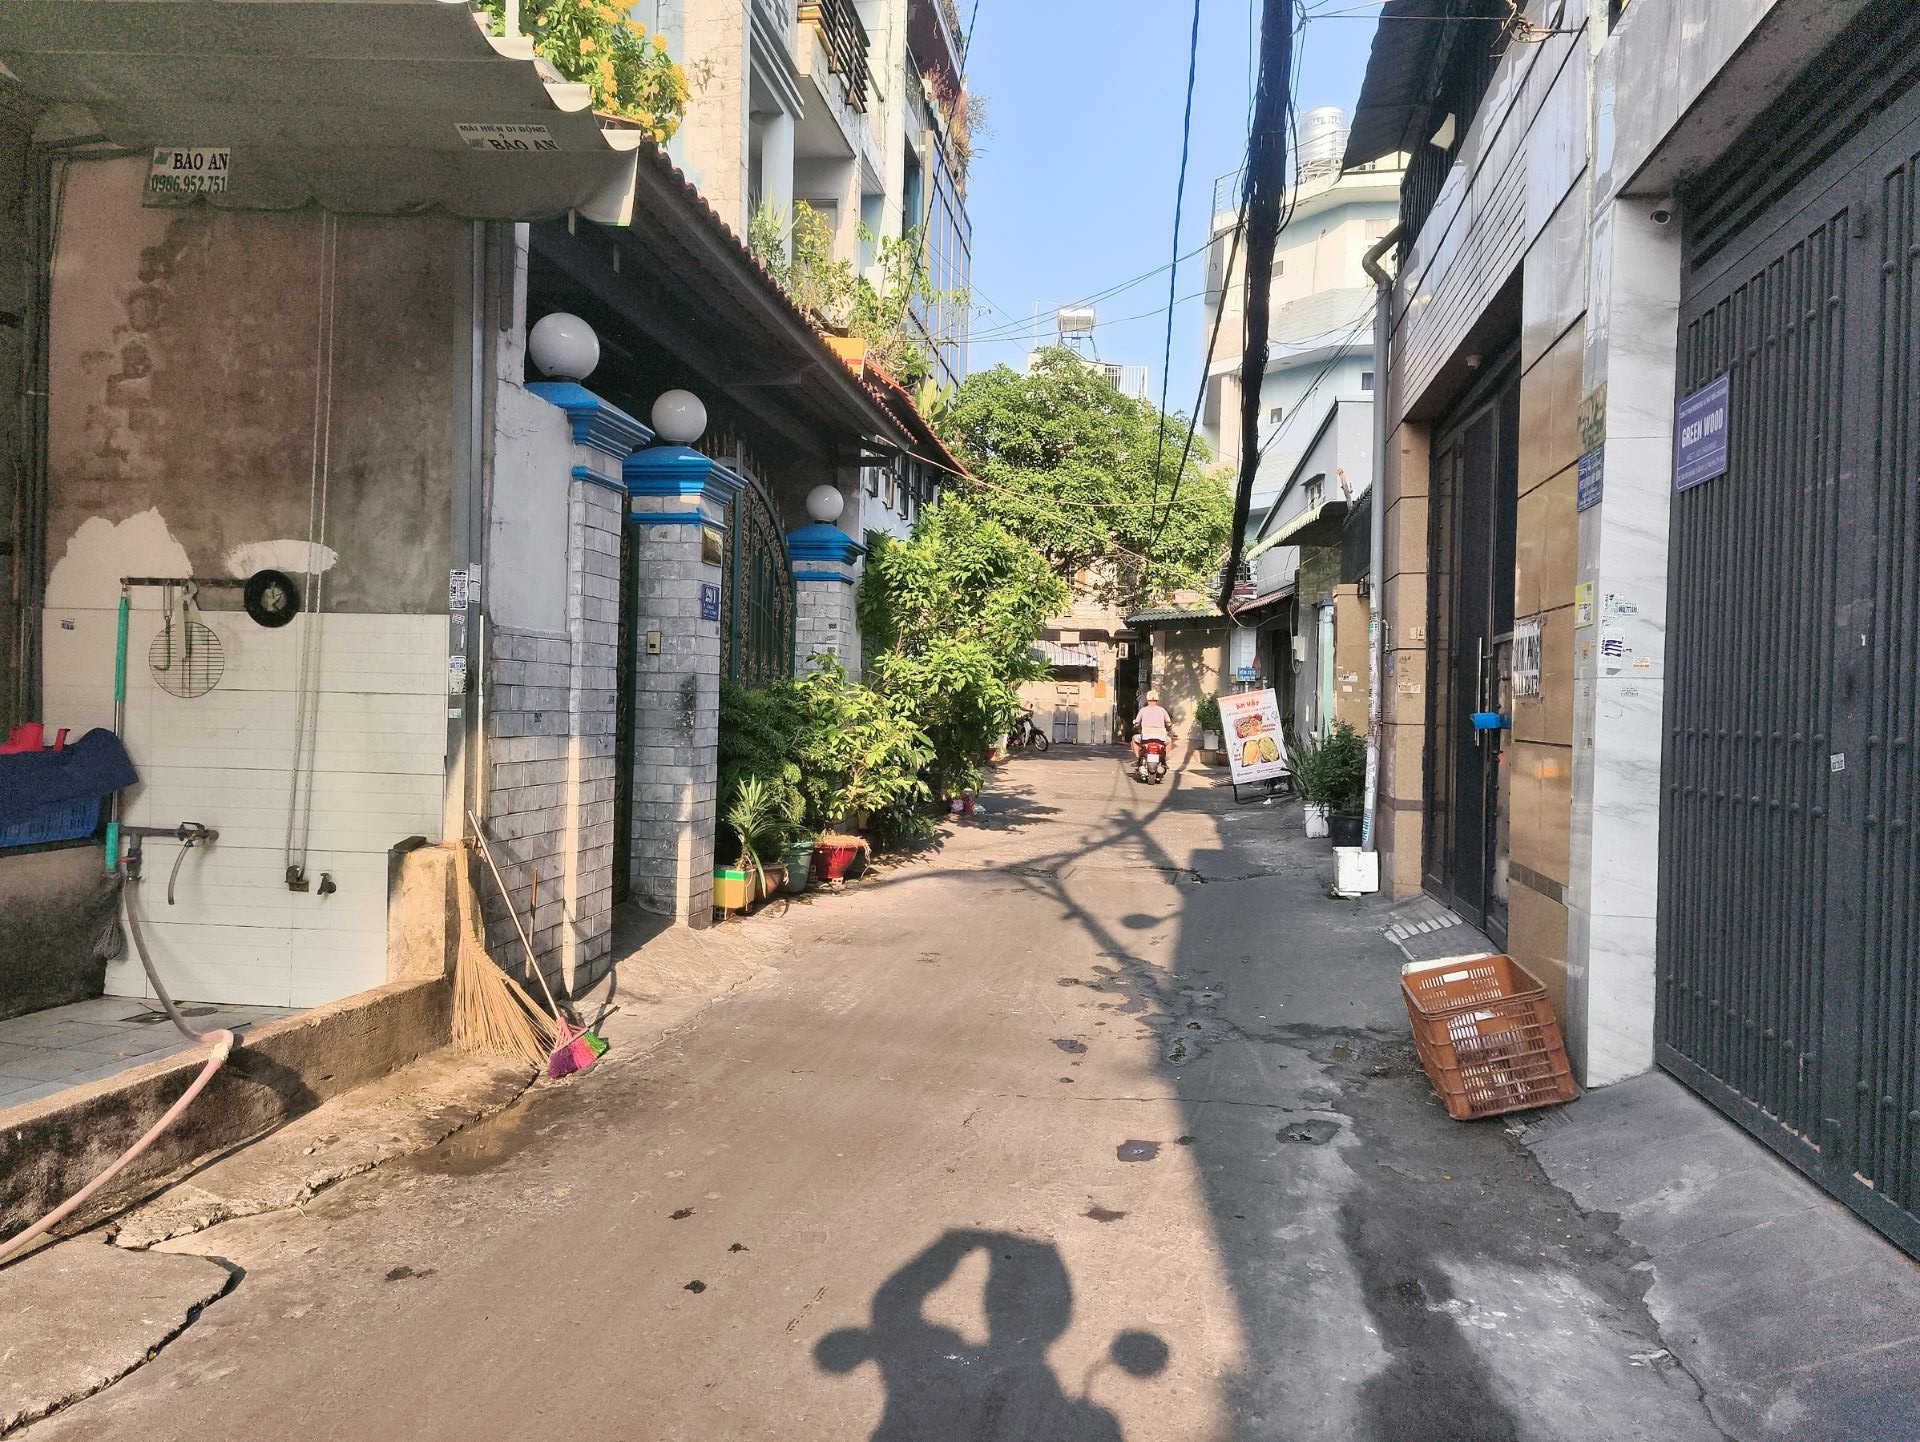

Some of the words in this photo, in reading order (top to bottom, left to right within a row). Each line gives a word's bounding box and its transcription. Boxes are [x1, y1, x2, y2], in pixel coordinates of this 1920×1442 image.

[487, 133, 529, 151] BẢO
[533, 140, 559, 151] AN
[208, 153, 229, 170] AN
[151, 174, 227, 194] 0986.952.751
[1681, 419, 1703, 449] GREEN
[1703, 407, 1724, 437] WOOD
